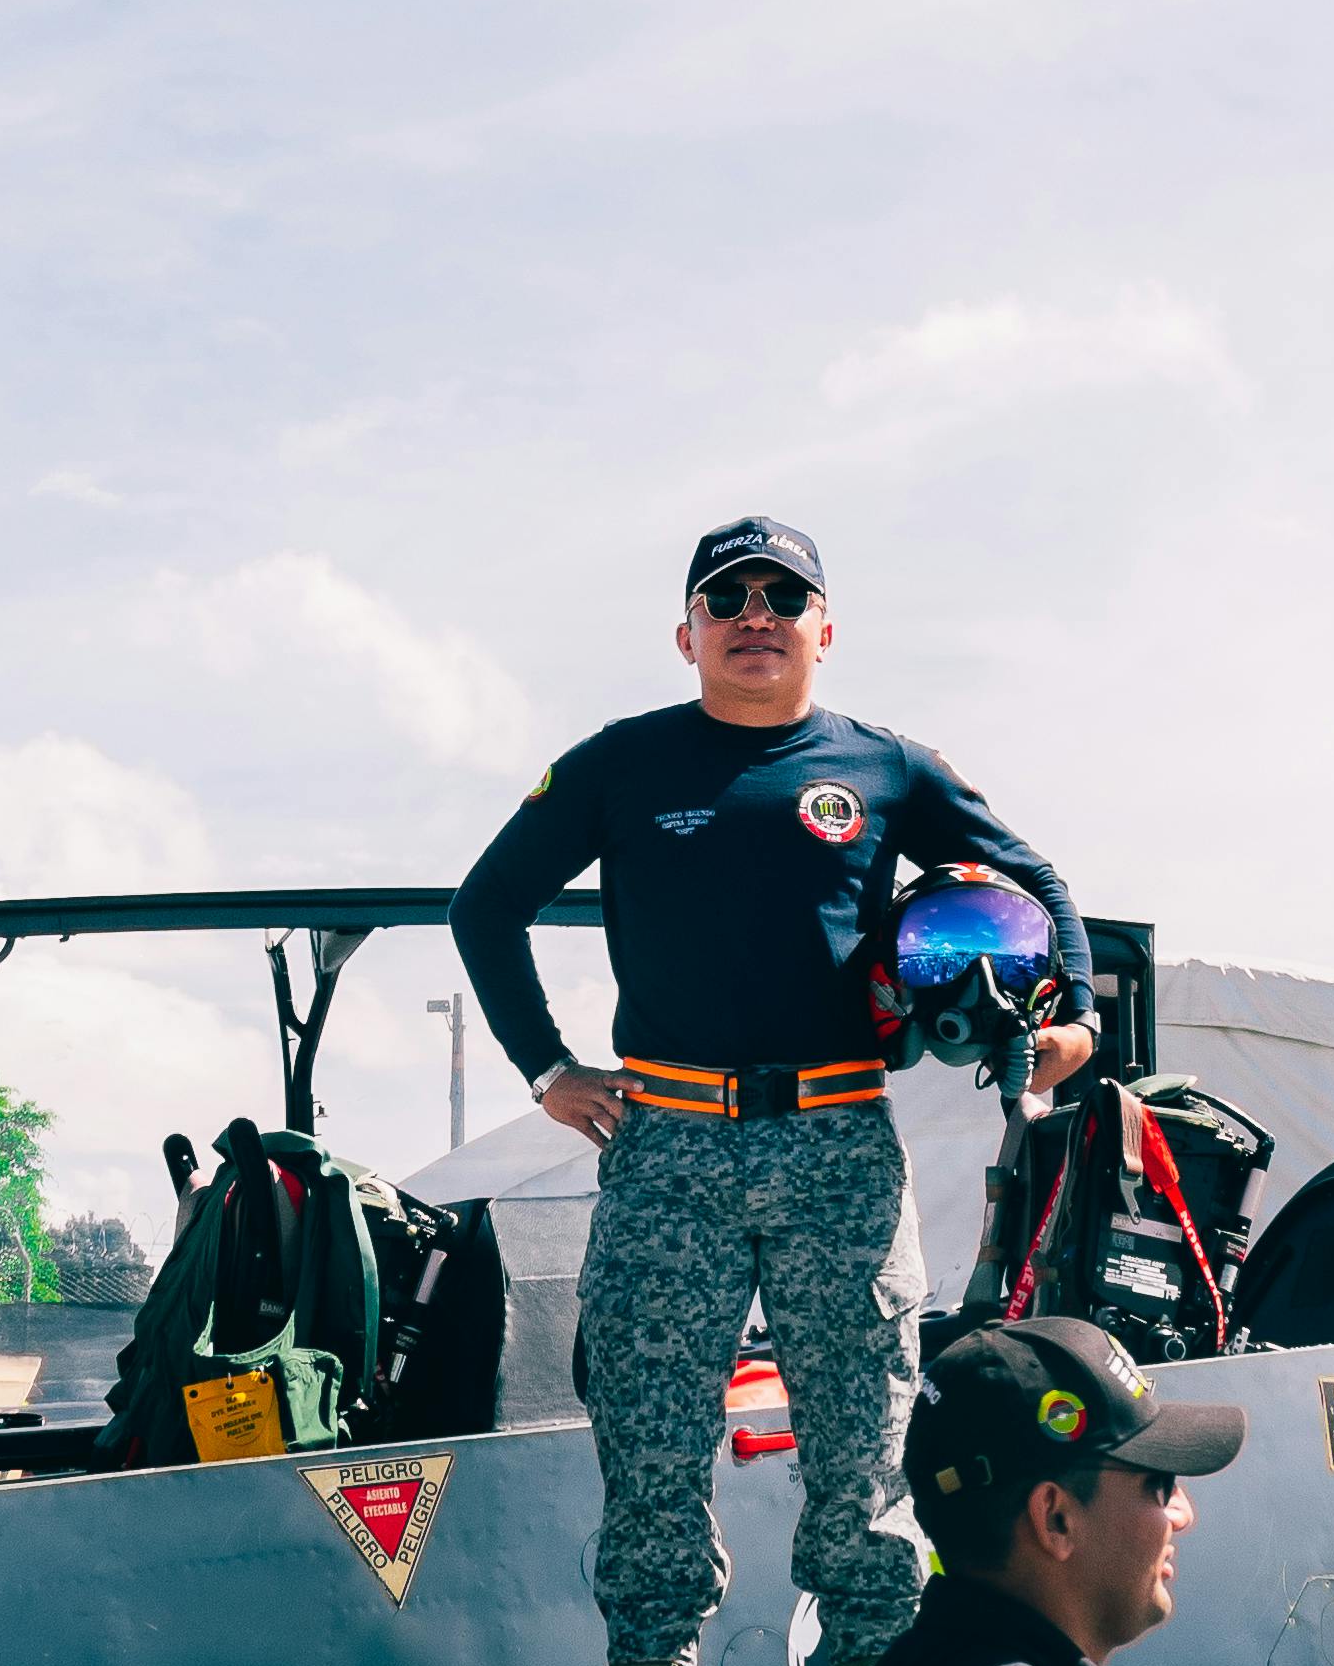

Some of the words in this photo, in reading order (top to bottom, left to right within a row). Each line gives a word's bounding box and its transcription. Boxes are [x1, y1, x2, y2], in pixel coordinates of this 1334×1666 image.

[711, 533, 763, 557] FUERZA
[766, 533, 808, 560] AÉREA
[339, 1461, 423, 1484] PELIGRO
[366, 1486, 401, 1502] ASIENTO
[363, 1501, 408, 1518] EYECTABLE
[326, 1491, 388, 1569] PELIGRO
[398, 1481, 439, 1566] PELIGRO
